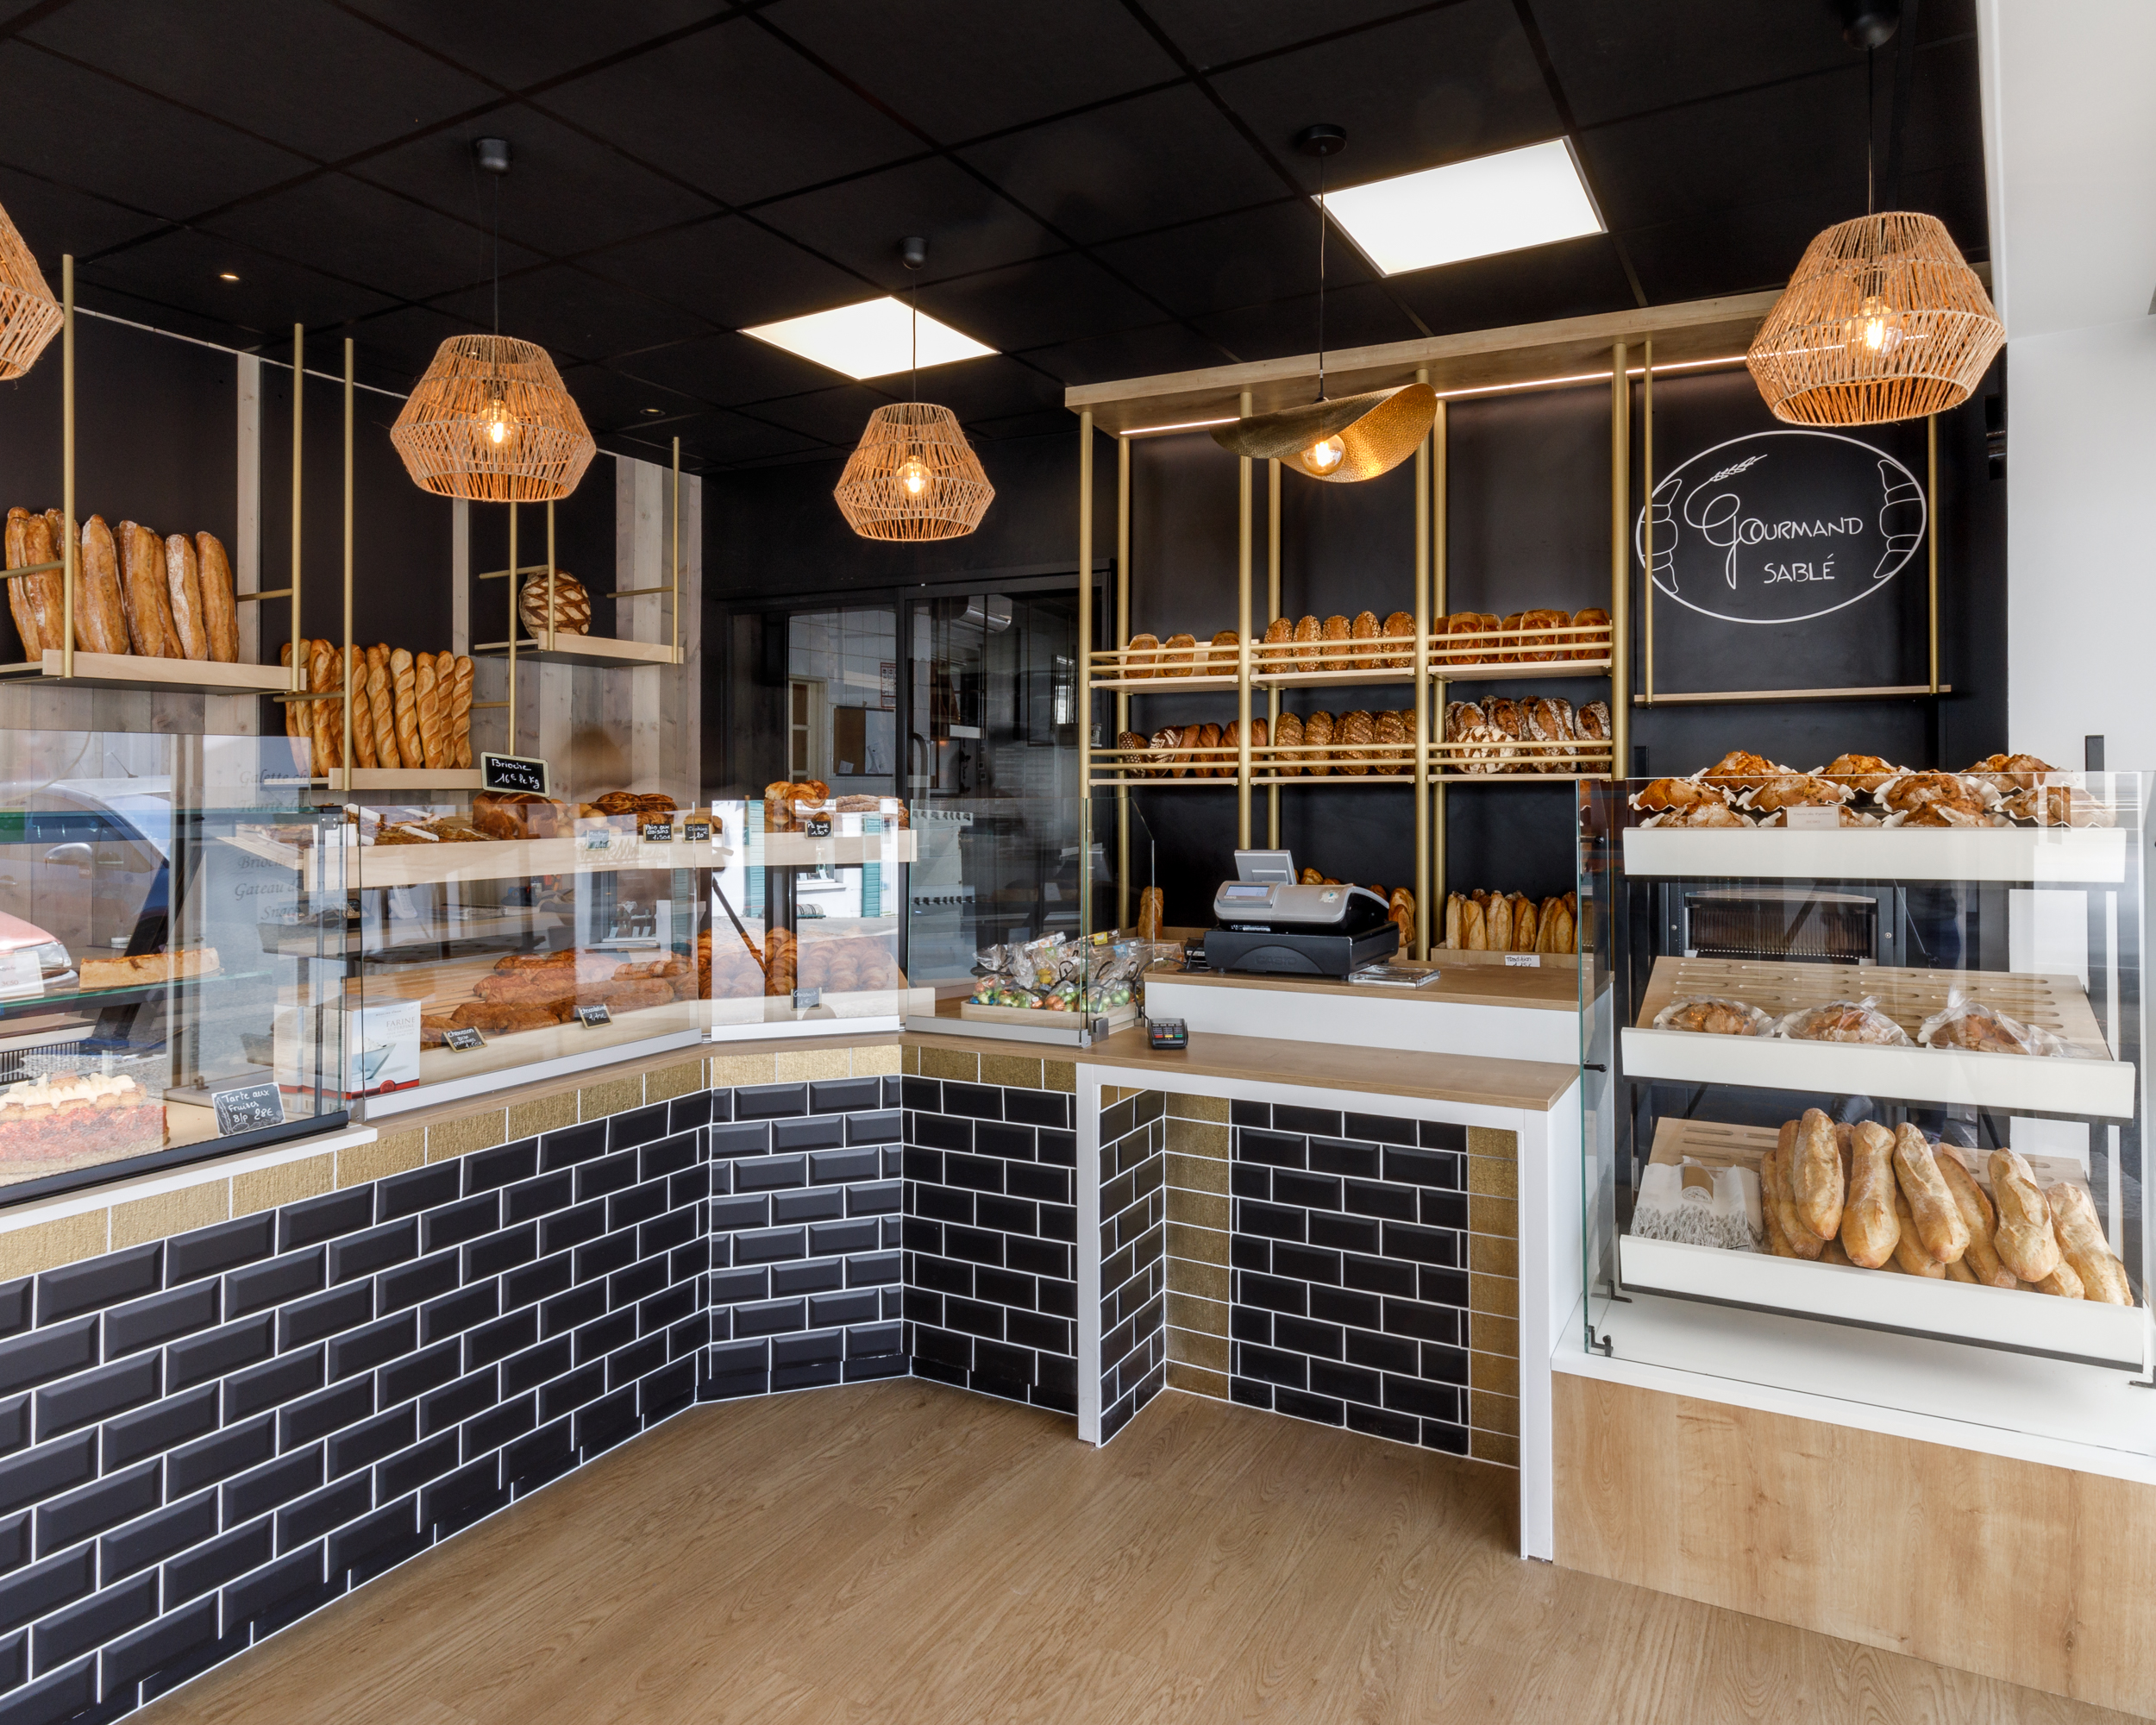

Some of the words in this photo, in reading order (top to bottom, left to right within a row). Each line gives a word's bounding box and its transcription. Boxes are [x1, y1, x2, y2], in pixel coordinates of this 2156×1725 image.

[1685, 492, 1863, 589] GOURMAND
[1764, 554, 1835, 584] SABLÉ
[491, 758, 531, 771] Brioche
[1255, 956, 1296, 966] CASIO
[386, 1016, 416, 1027] FARINE
[222, 1092, 250, 1102] Tarte
[252, 1089, 269, 1098] aux
[254, 1107, 274, 1120] 28€
